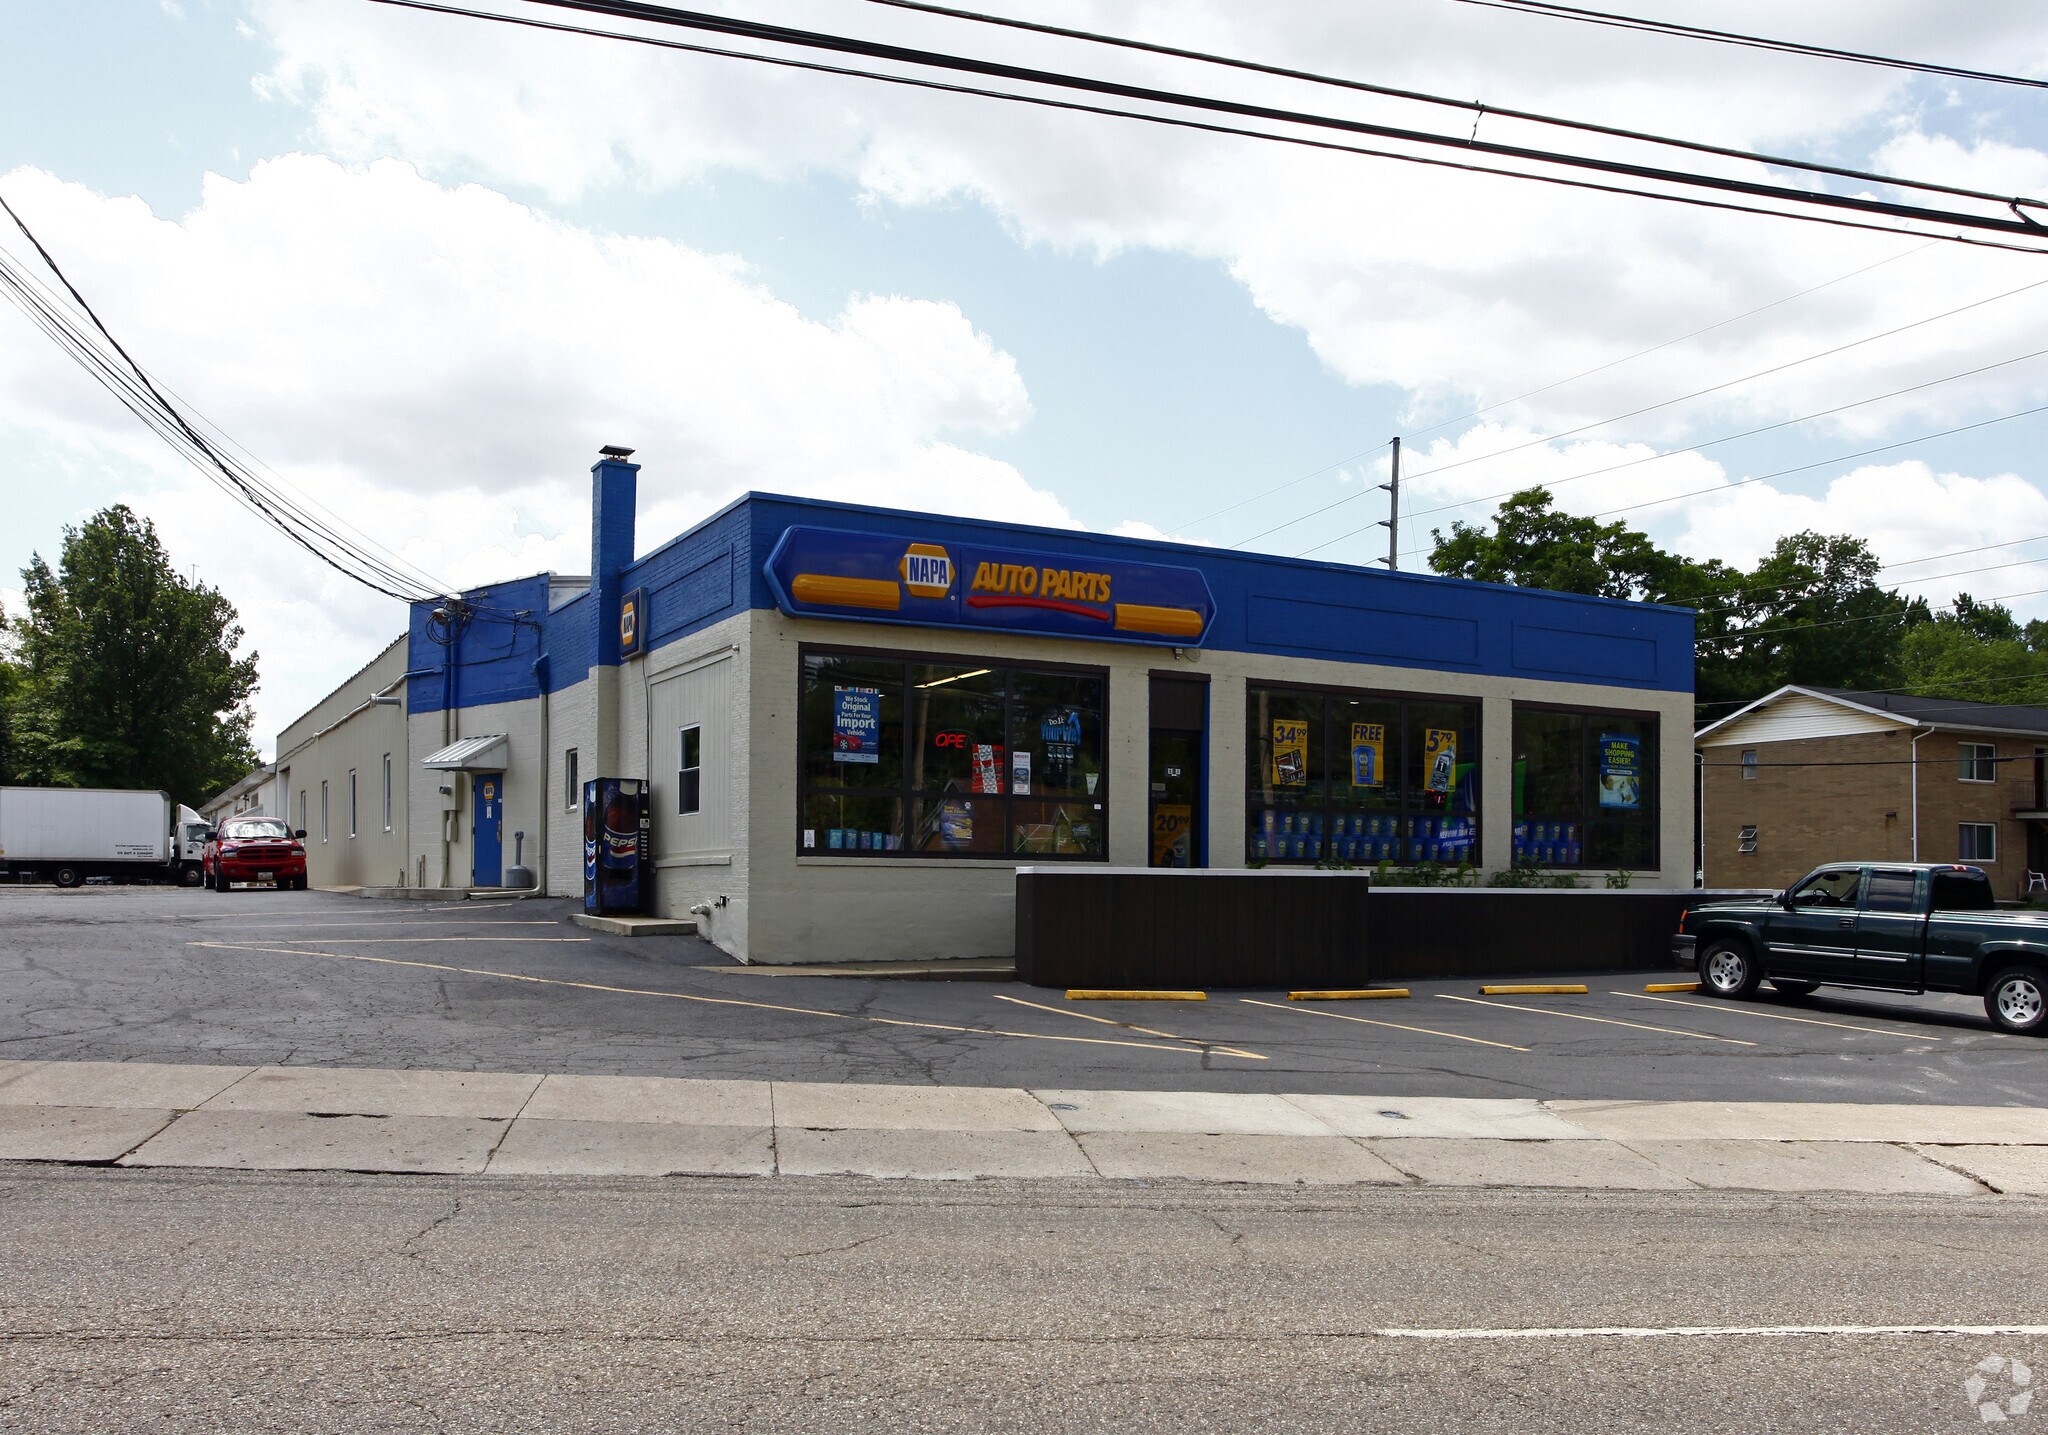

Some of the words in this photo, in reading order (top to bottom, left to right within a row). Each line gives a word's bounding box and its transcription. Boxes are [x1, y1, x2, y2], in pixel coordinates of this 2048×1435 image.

[909, 556, 948, 585] NAPA
[971, 561, 1039, 596] AUTO
[1040, 567, 1112, 603] PARTS
[854, 695, 868, 703] Stock
[842, 701, 871, 712] Original
[836, 714, 876, 730] Import
[1353, 724, 1382, 741] FREE
[1611, 741, 1629, 750] MAKE
[1604, 748, 1635, 758] SHOPPING
[1608, 756, 1632, 765] EASIER!
[603, 832, 639, 848] PEPSI
